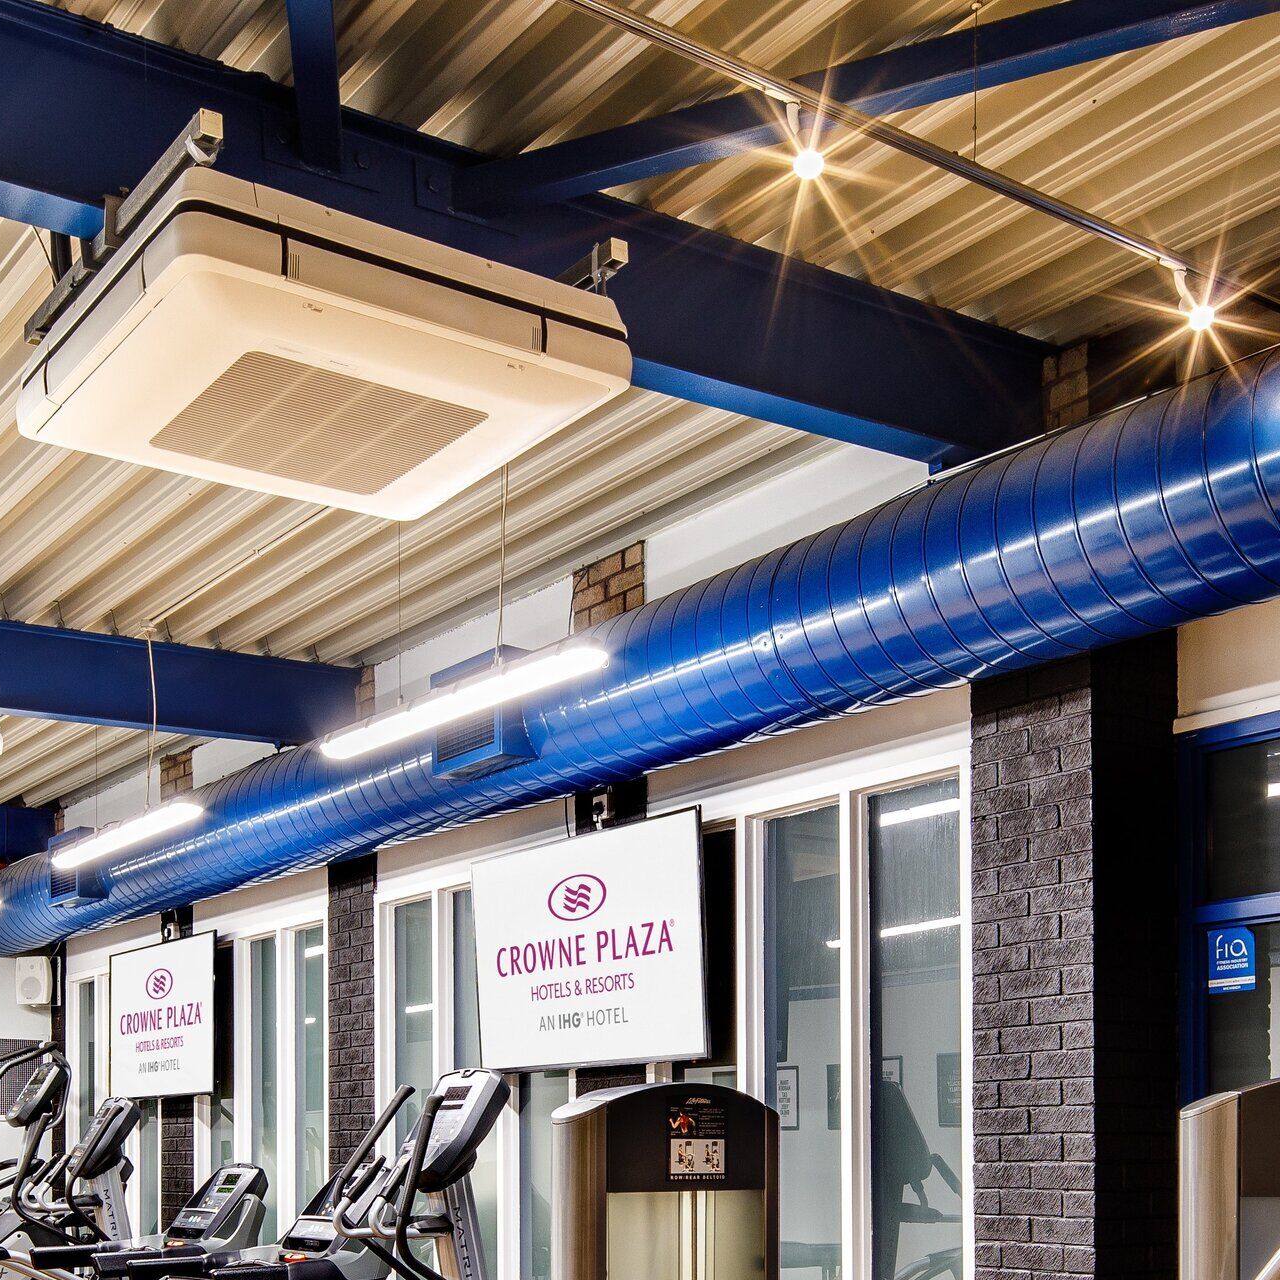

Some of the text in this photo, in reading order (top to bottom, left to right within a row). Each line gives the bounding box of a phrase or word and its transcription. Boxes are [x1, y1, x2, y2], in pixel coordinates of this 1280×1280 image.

[496, 919, 673, 977] CROWNE PLAZA
[531, 972, 635, 1001] HOTELS & RESORTS
[120, 1002, 201, 1035] CROWNE PLAZA
[539, 1007, 628, 1031] AN IHG HOTEL
[136, 1036, 183, 1052] HOTELS & RESORTS
[138, 1059, 180, 1074] AN IHG HOTEL
[103, 1189, 119, 1240] MATRI
